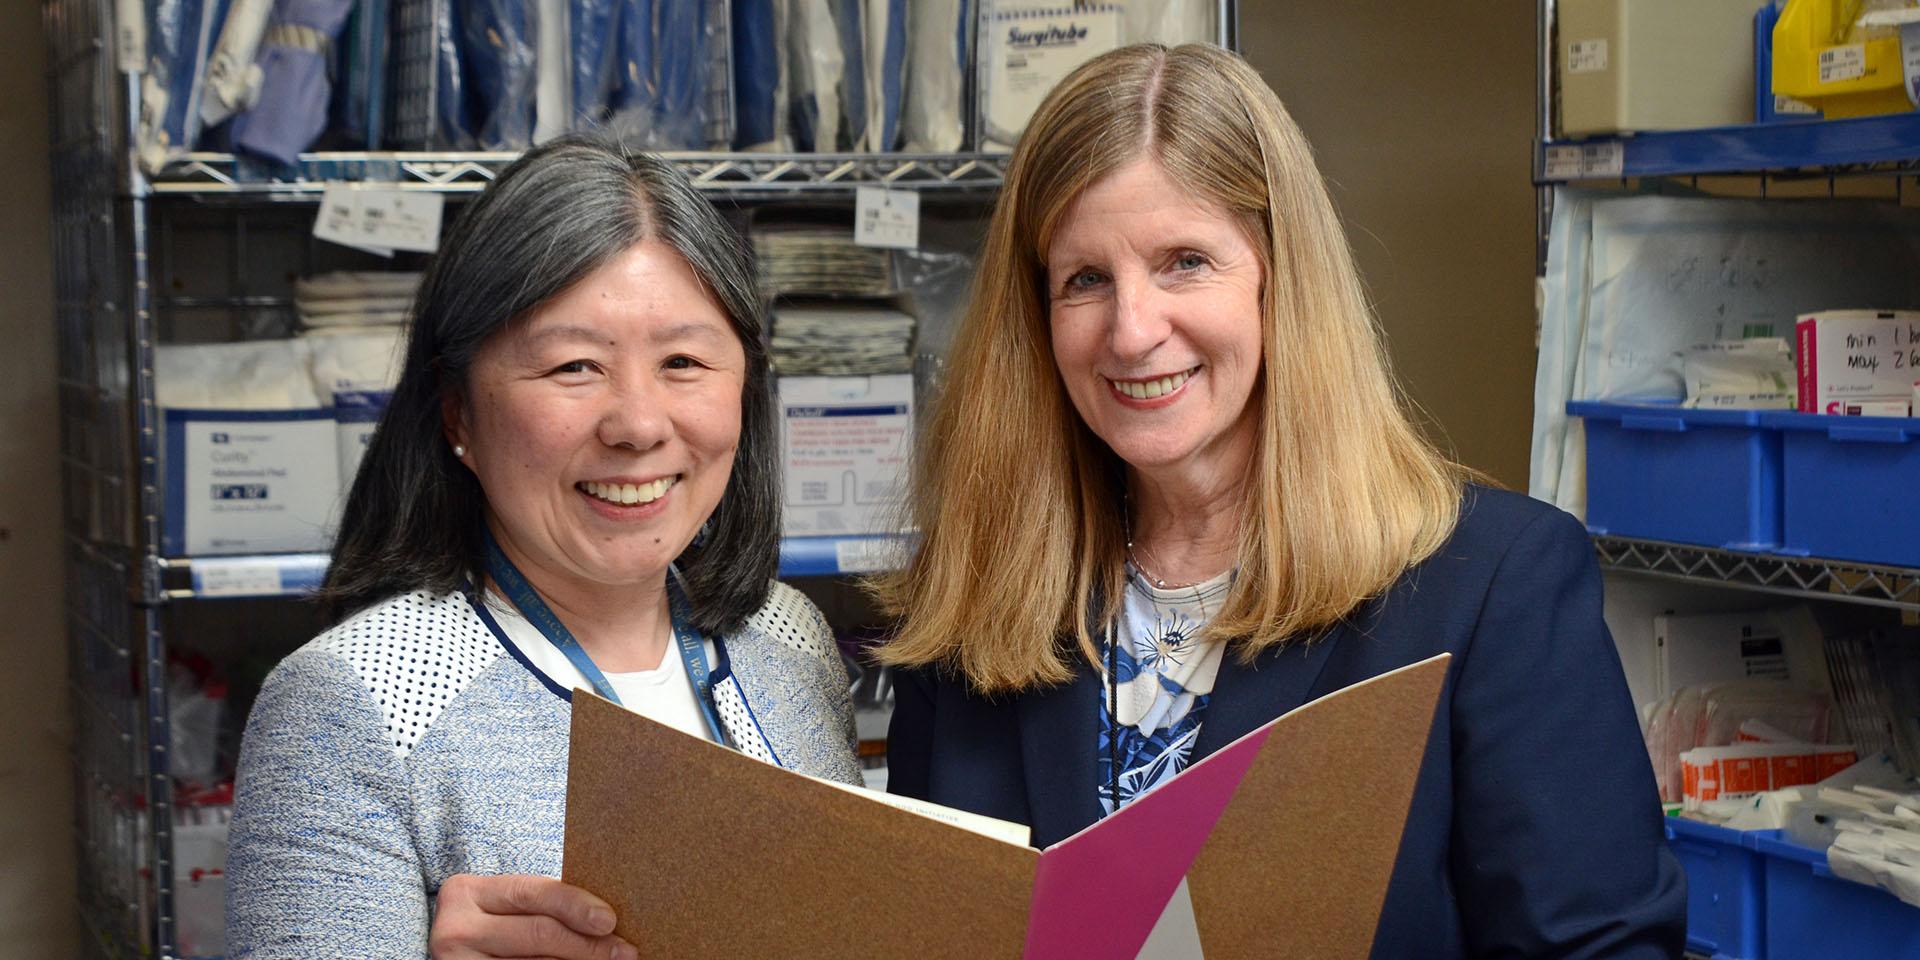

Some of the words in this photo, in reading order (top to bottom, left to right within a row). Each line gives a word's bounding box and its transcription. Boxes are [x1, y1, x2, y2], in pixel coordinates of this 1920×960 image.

[1005, 23, 1088, 48] Surgitube
[1846, 332, 1877, 350] min
[689, 657, 706, 677] we
